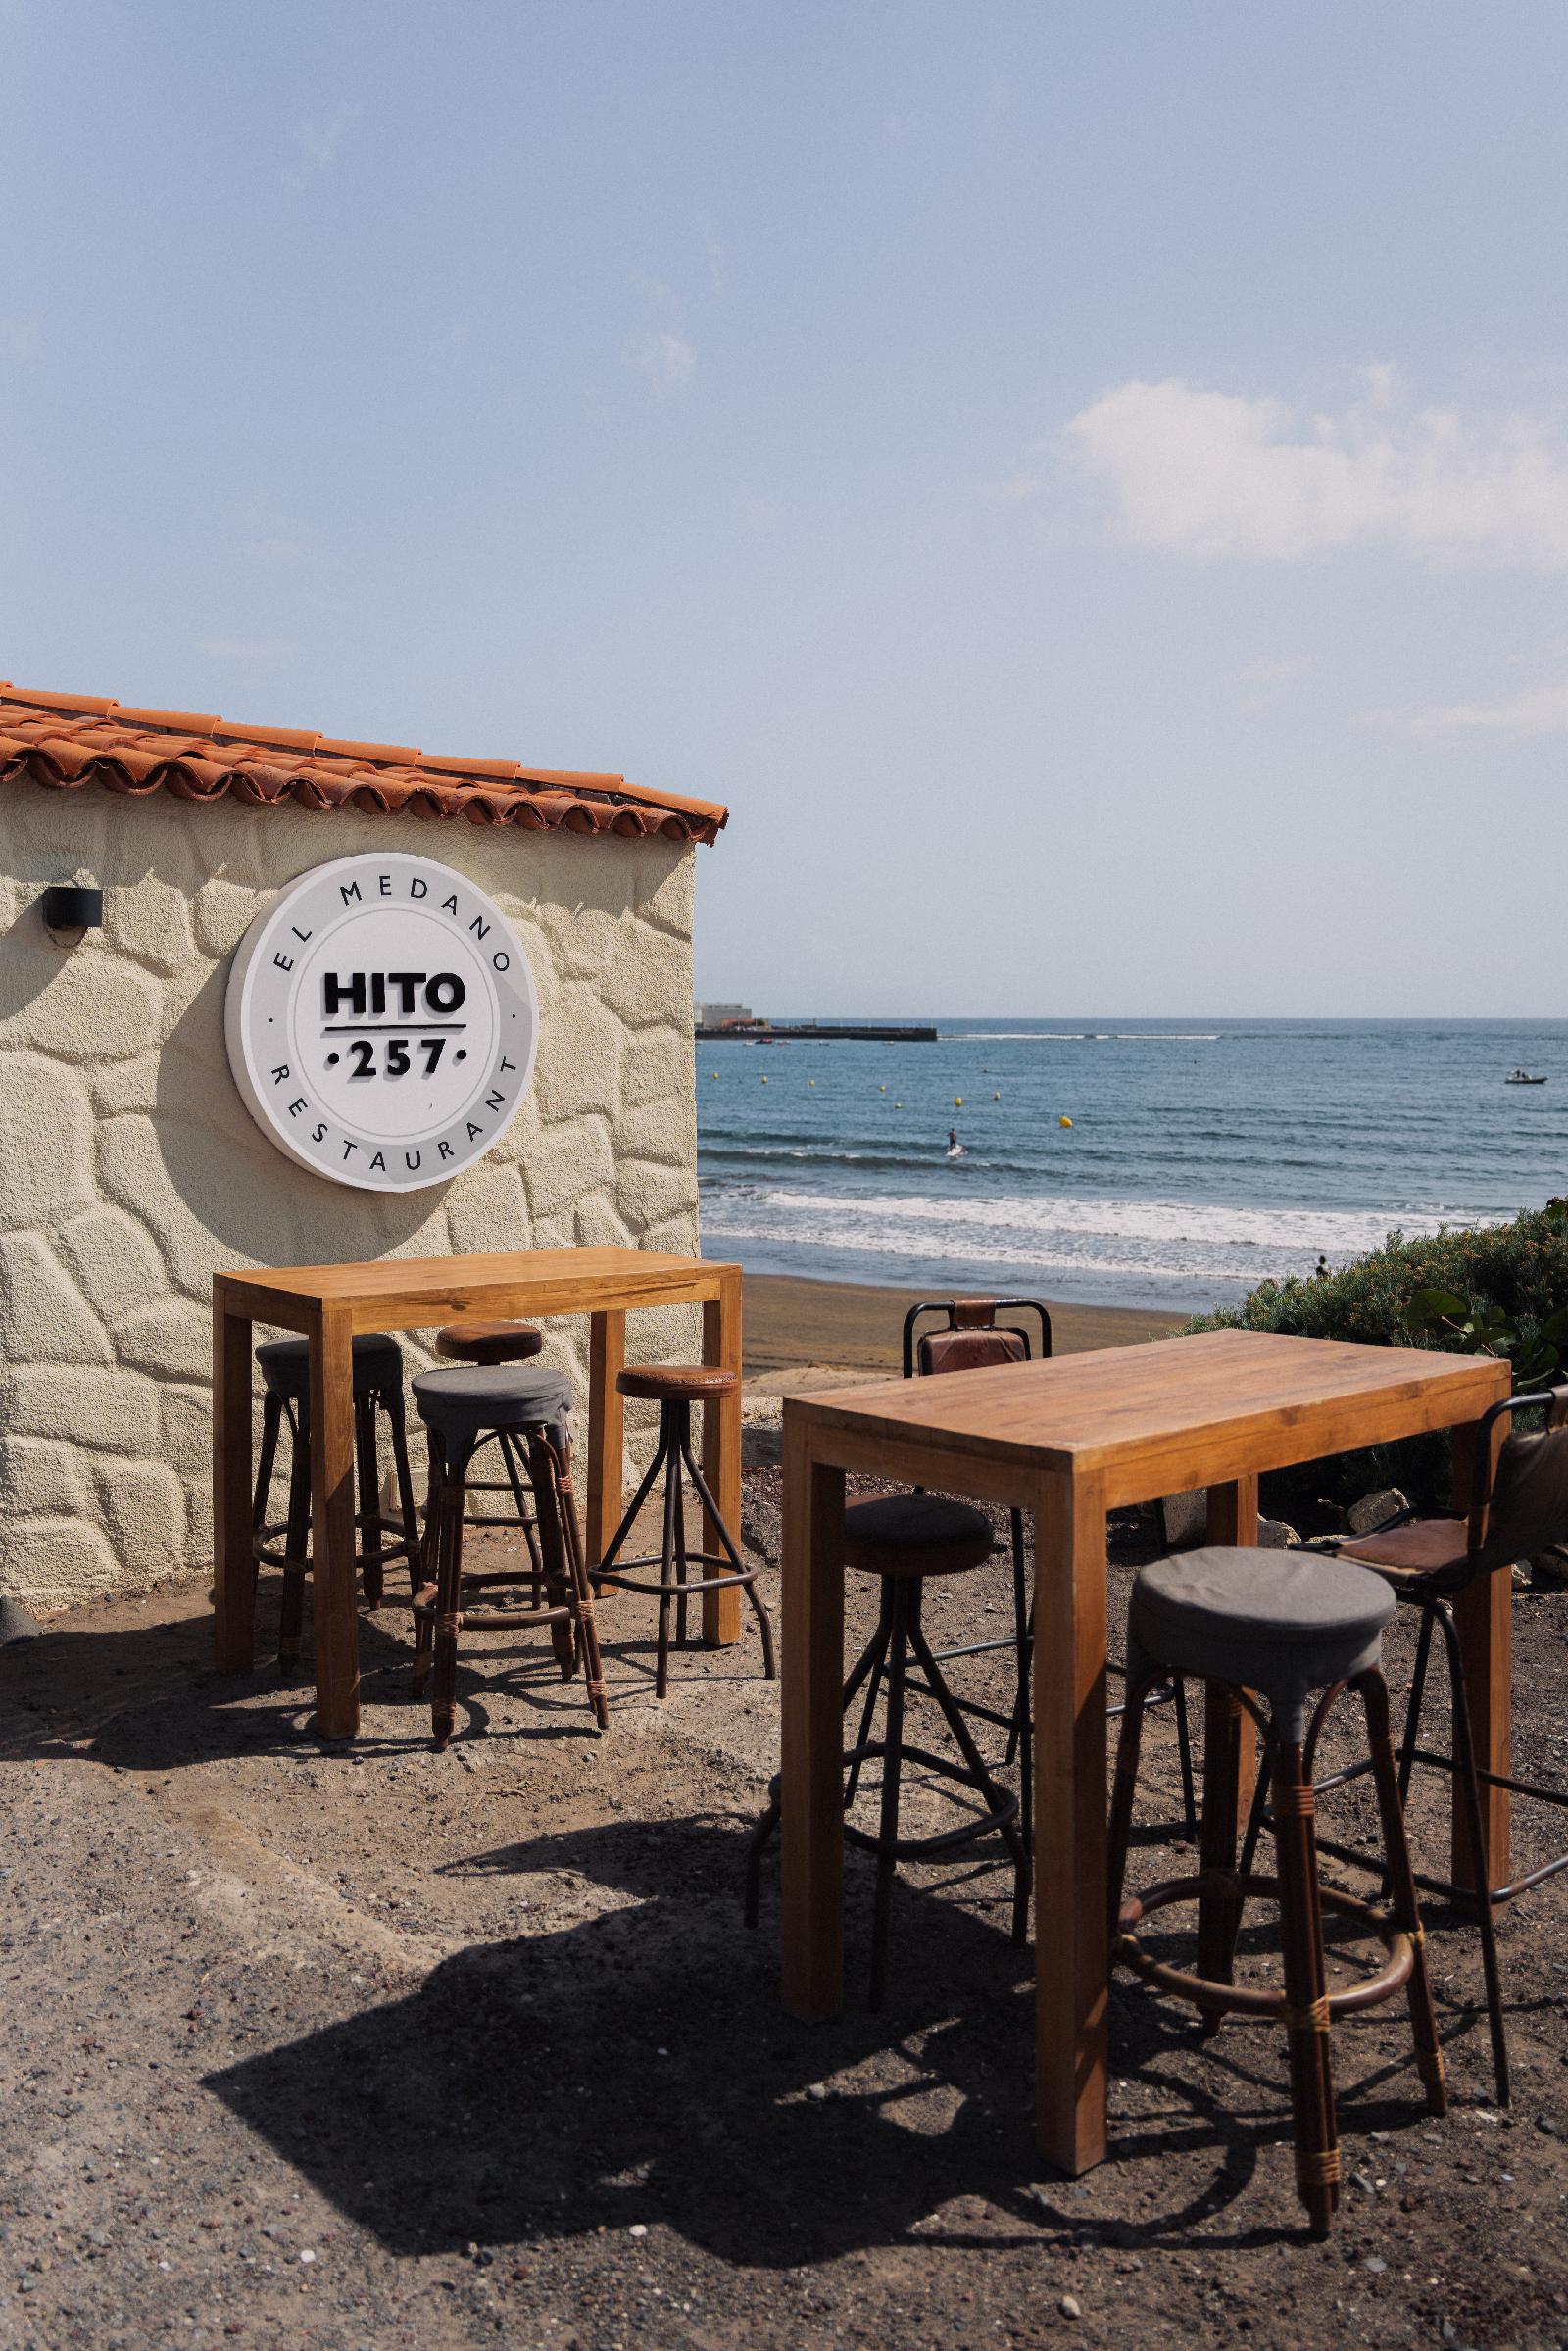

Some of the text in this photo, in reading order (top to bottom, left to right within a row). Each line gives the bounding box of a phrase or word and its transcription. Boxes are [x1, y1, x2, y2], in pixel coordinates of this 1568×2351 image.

[273, 875, 510, 971] EL MEDANO
[324, 972, 466, 1013] HITO
[270, 1055, 517, 1171] RESTAURANT
